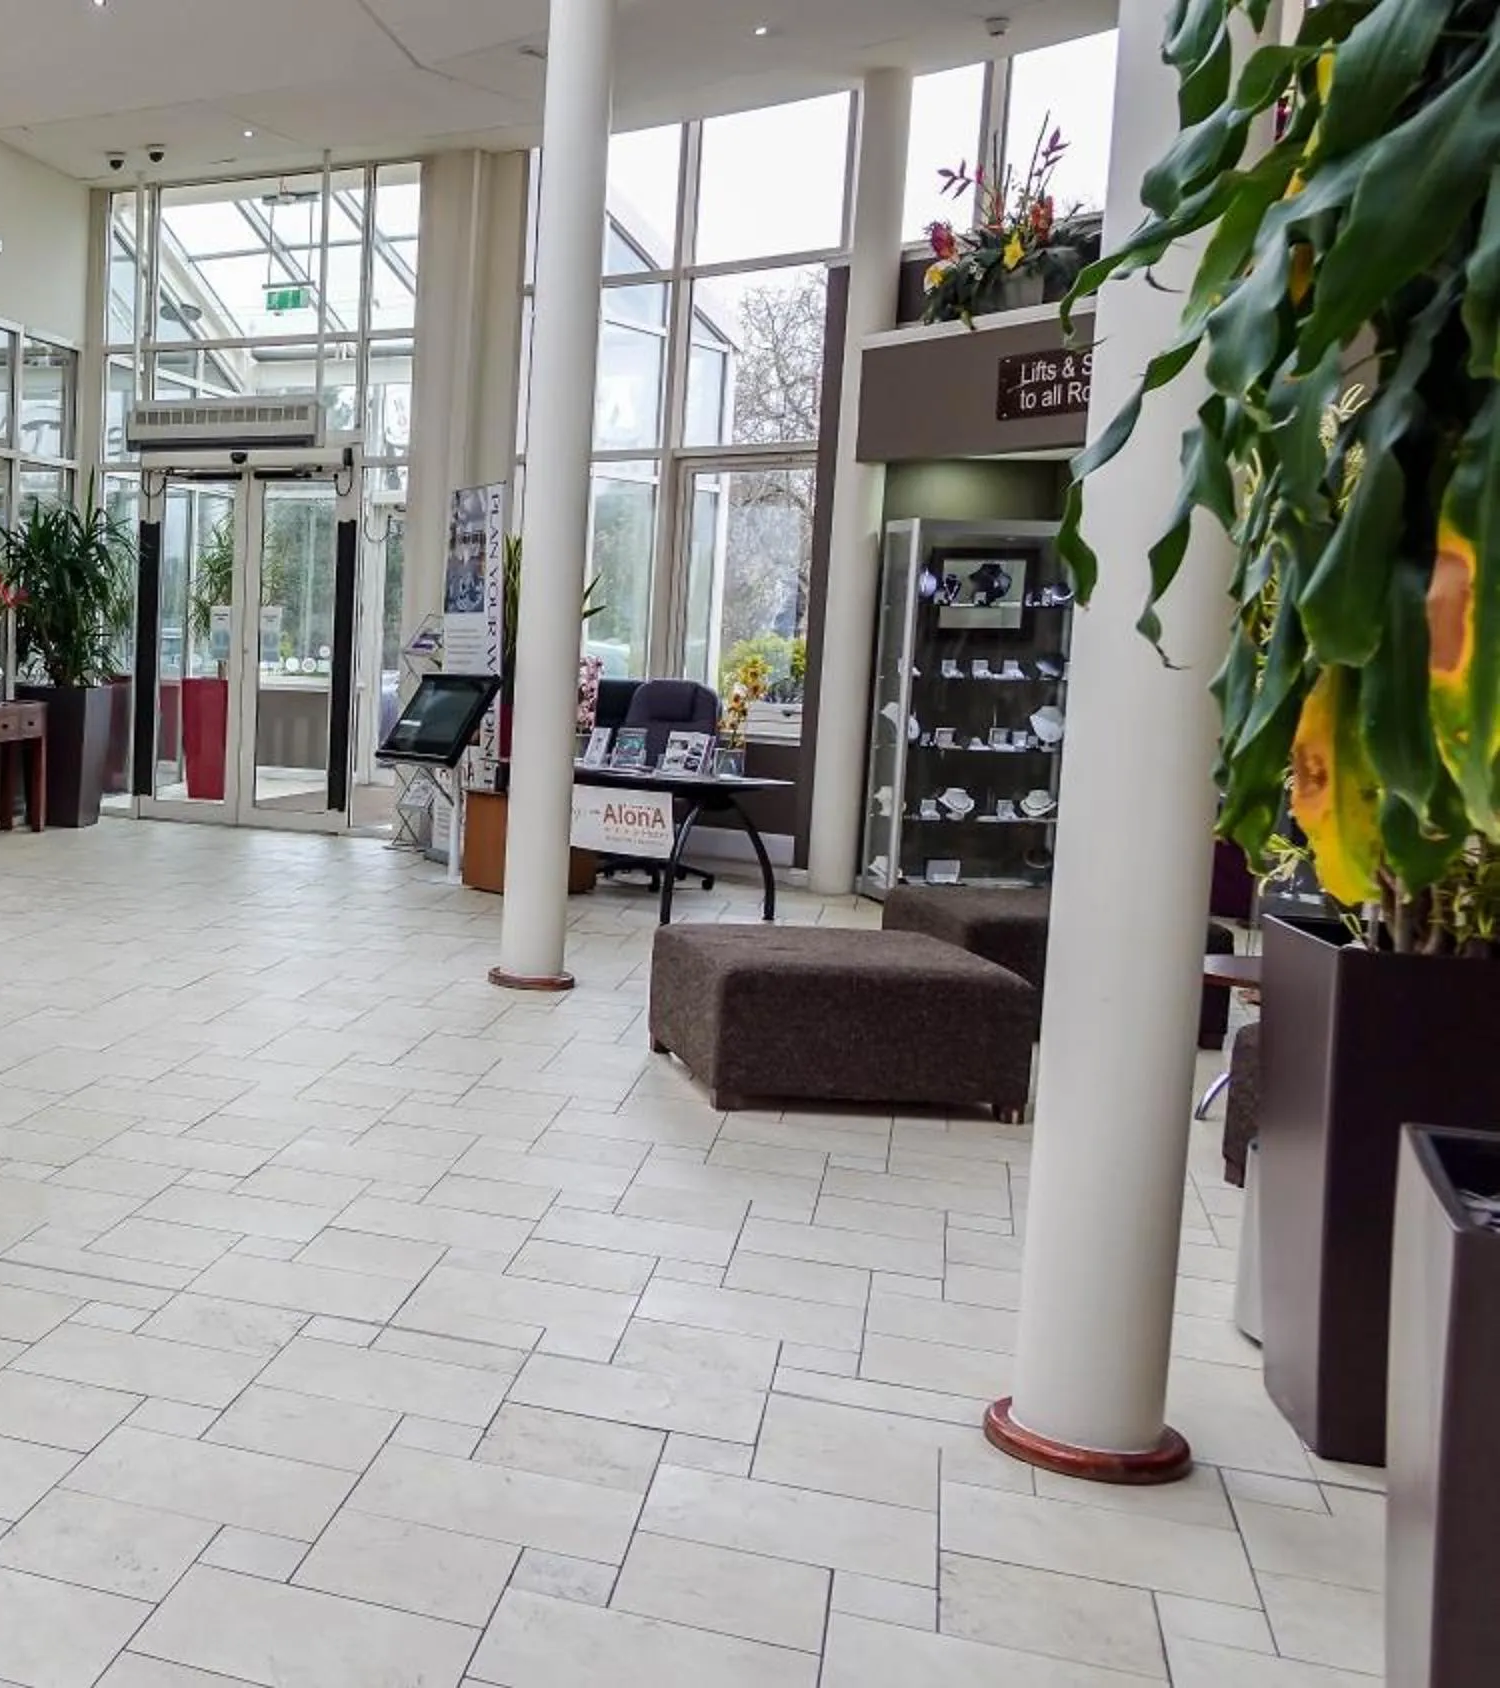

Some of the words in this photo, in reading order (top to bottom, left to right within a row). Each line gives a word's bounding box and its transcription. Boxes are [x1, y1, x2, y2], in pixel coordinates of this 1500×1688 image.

[1021, 360, 1057, 384] Lifts
[1062, 355, 1075, 378] &
[1081, 353, 1092, 375] S
[1020, 389, 1037, 410] to
[1041, 384, 1062, 407] all
[1067, 381, 1092, 404] Ro
[489, 493, 499, 559] PLAN
[488, 567, 499, 637] YOUR
[603, 803, 666, 829] AlonA
